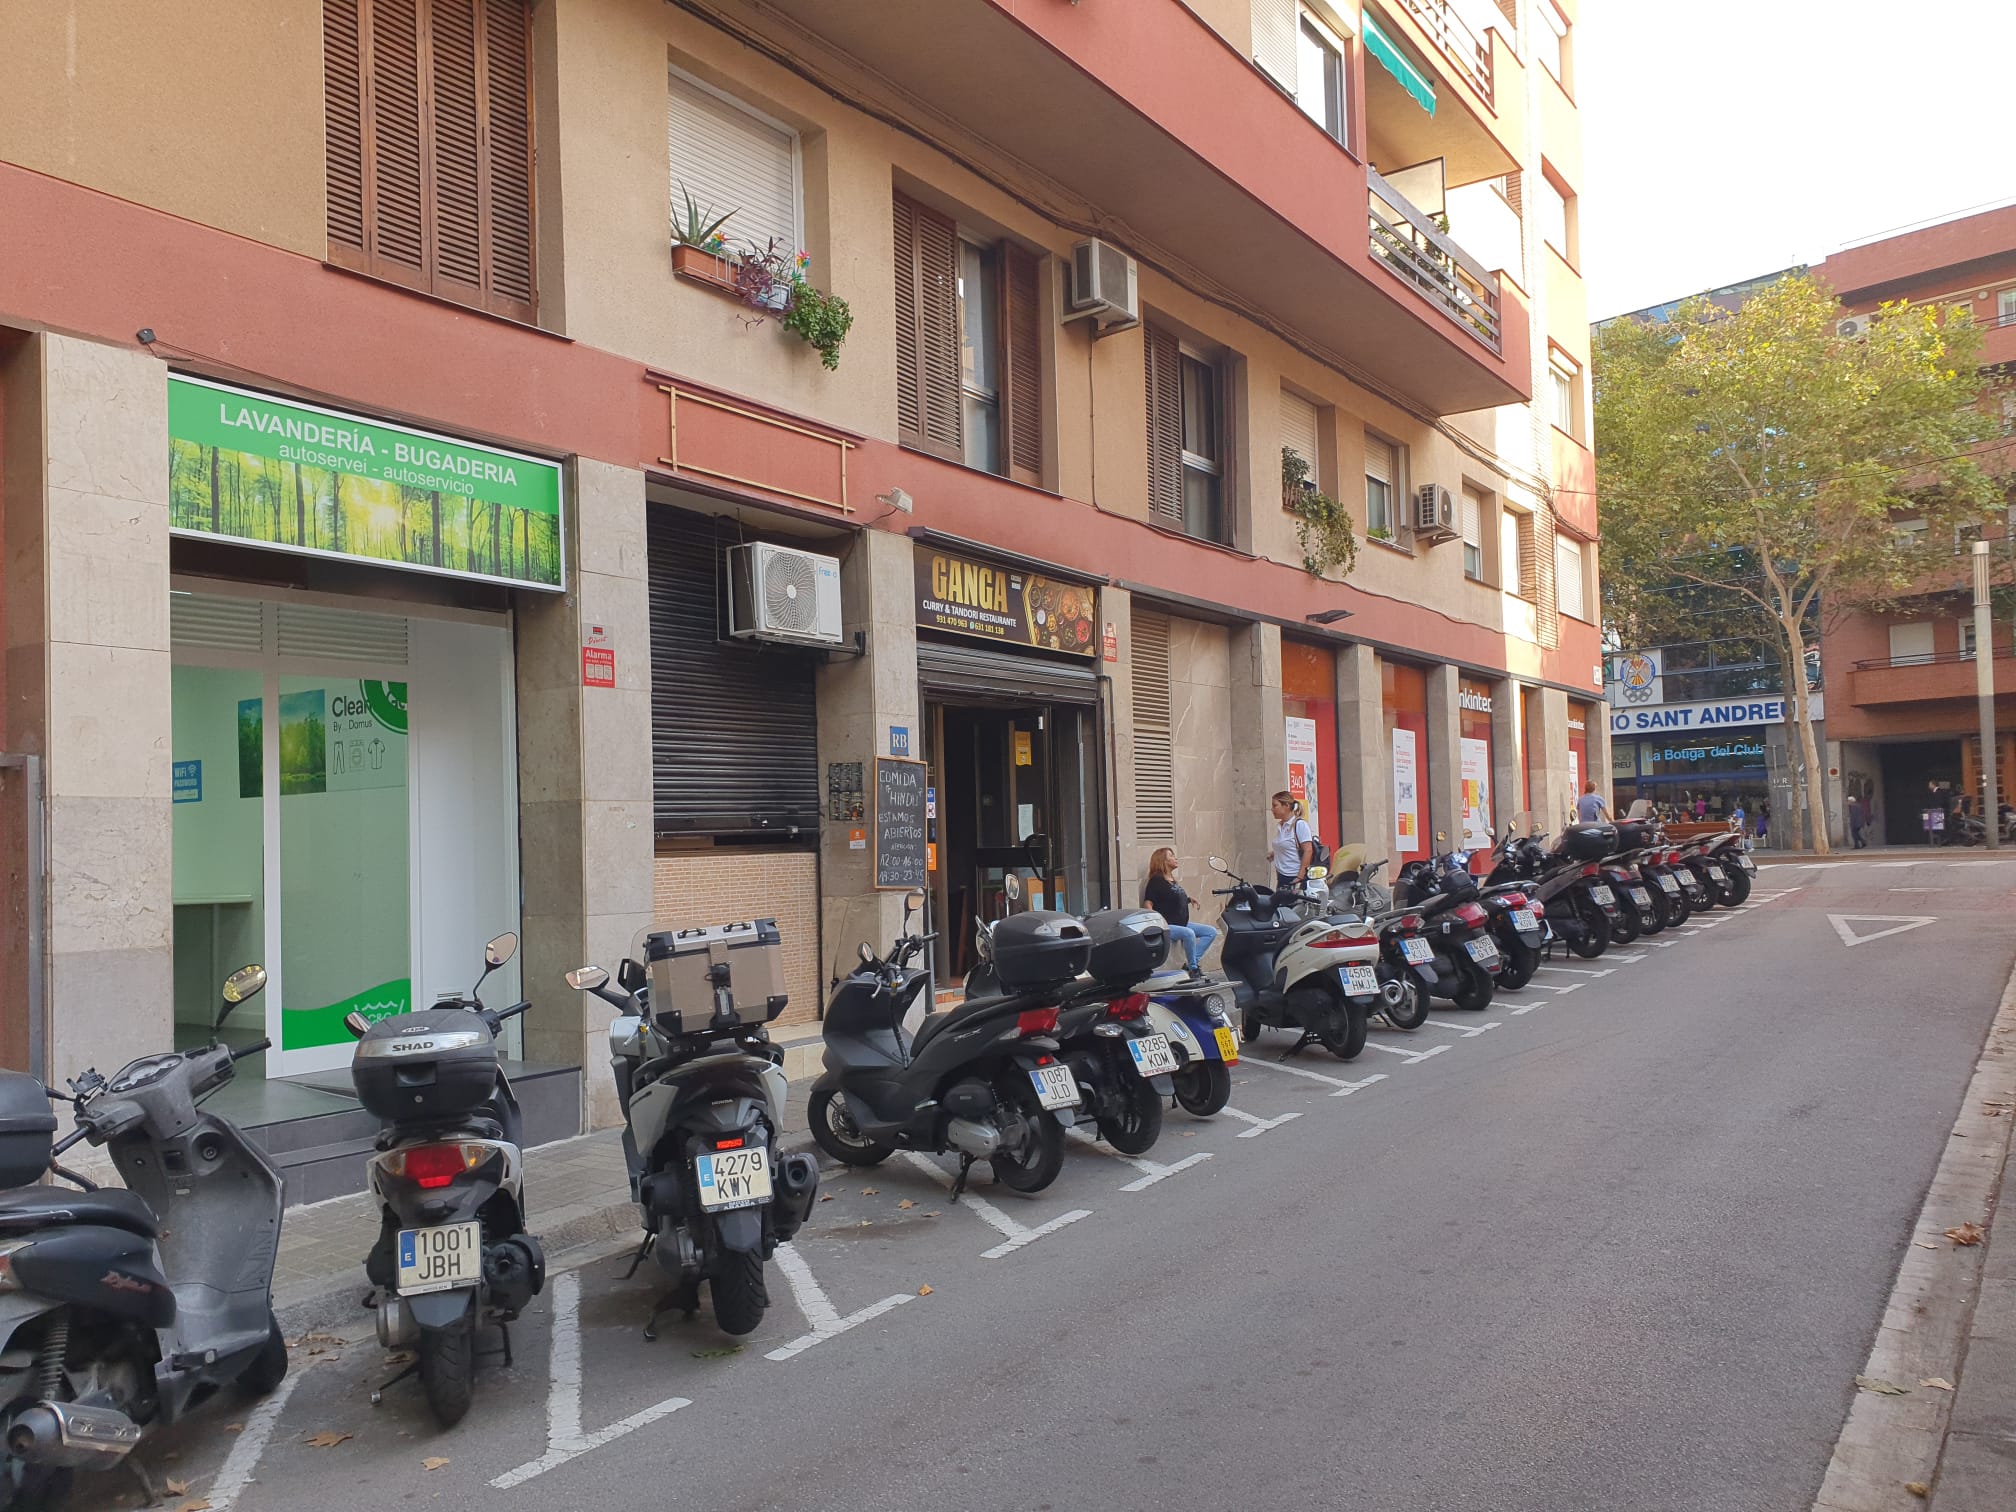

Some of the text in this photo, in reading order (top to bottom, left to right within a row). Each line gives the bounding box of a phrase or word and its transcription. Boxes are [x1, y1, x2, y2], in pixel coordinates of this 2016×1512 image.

[220, 403, 376, 457] LAVANDERÍA
[395, 442, 518, 487] BUGADERIA
[279, 444, 368, 475] autoservei
[383, 466, 475, 495] autoservicio
[932, 555, 1009, 614] GANGA
[922, 599, 945, 613] CURRY
[951, 605, 979, 620] TANDORI
[979, 612, 1017, 628] RESTAURANTE
[348, 719, 373, 731] Domus
[1636, 708, 1693, 729] SANT
[1645, 751, 1661, 763] La
[1664, 748, 1706, 762] Botiga
[1711, 746, 1731, 758] del
[1734, 744, 1765, 757] Club
[879, 769, 917, 788] COMIDA
[878, 811, 916, 824] ESTAMOS
[1348, 967, 1373, 979] 4508
[1352, 979, 1371, 991] HMJ
[392, 1042, 434, 1053] SHAD
[1139, 1036, 1168, 1054] 3285
[1147, 1052, 1171, 1068] KDM
[1040, 1066, 1068, 1086] 1087
[1051, 1083, 1071, 1100] JLD
[714, 1151, 762, 1178] 4279
[717, 1174, 752, 1200] KWY
[420, 1226, 472, 1256] 1001
[418, 1252, 461, 1280] JBH
